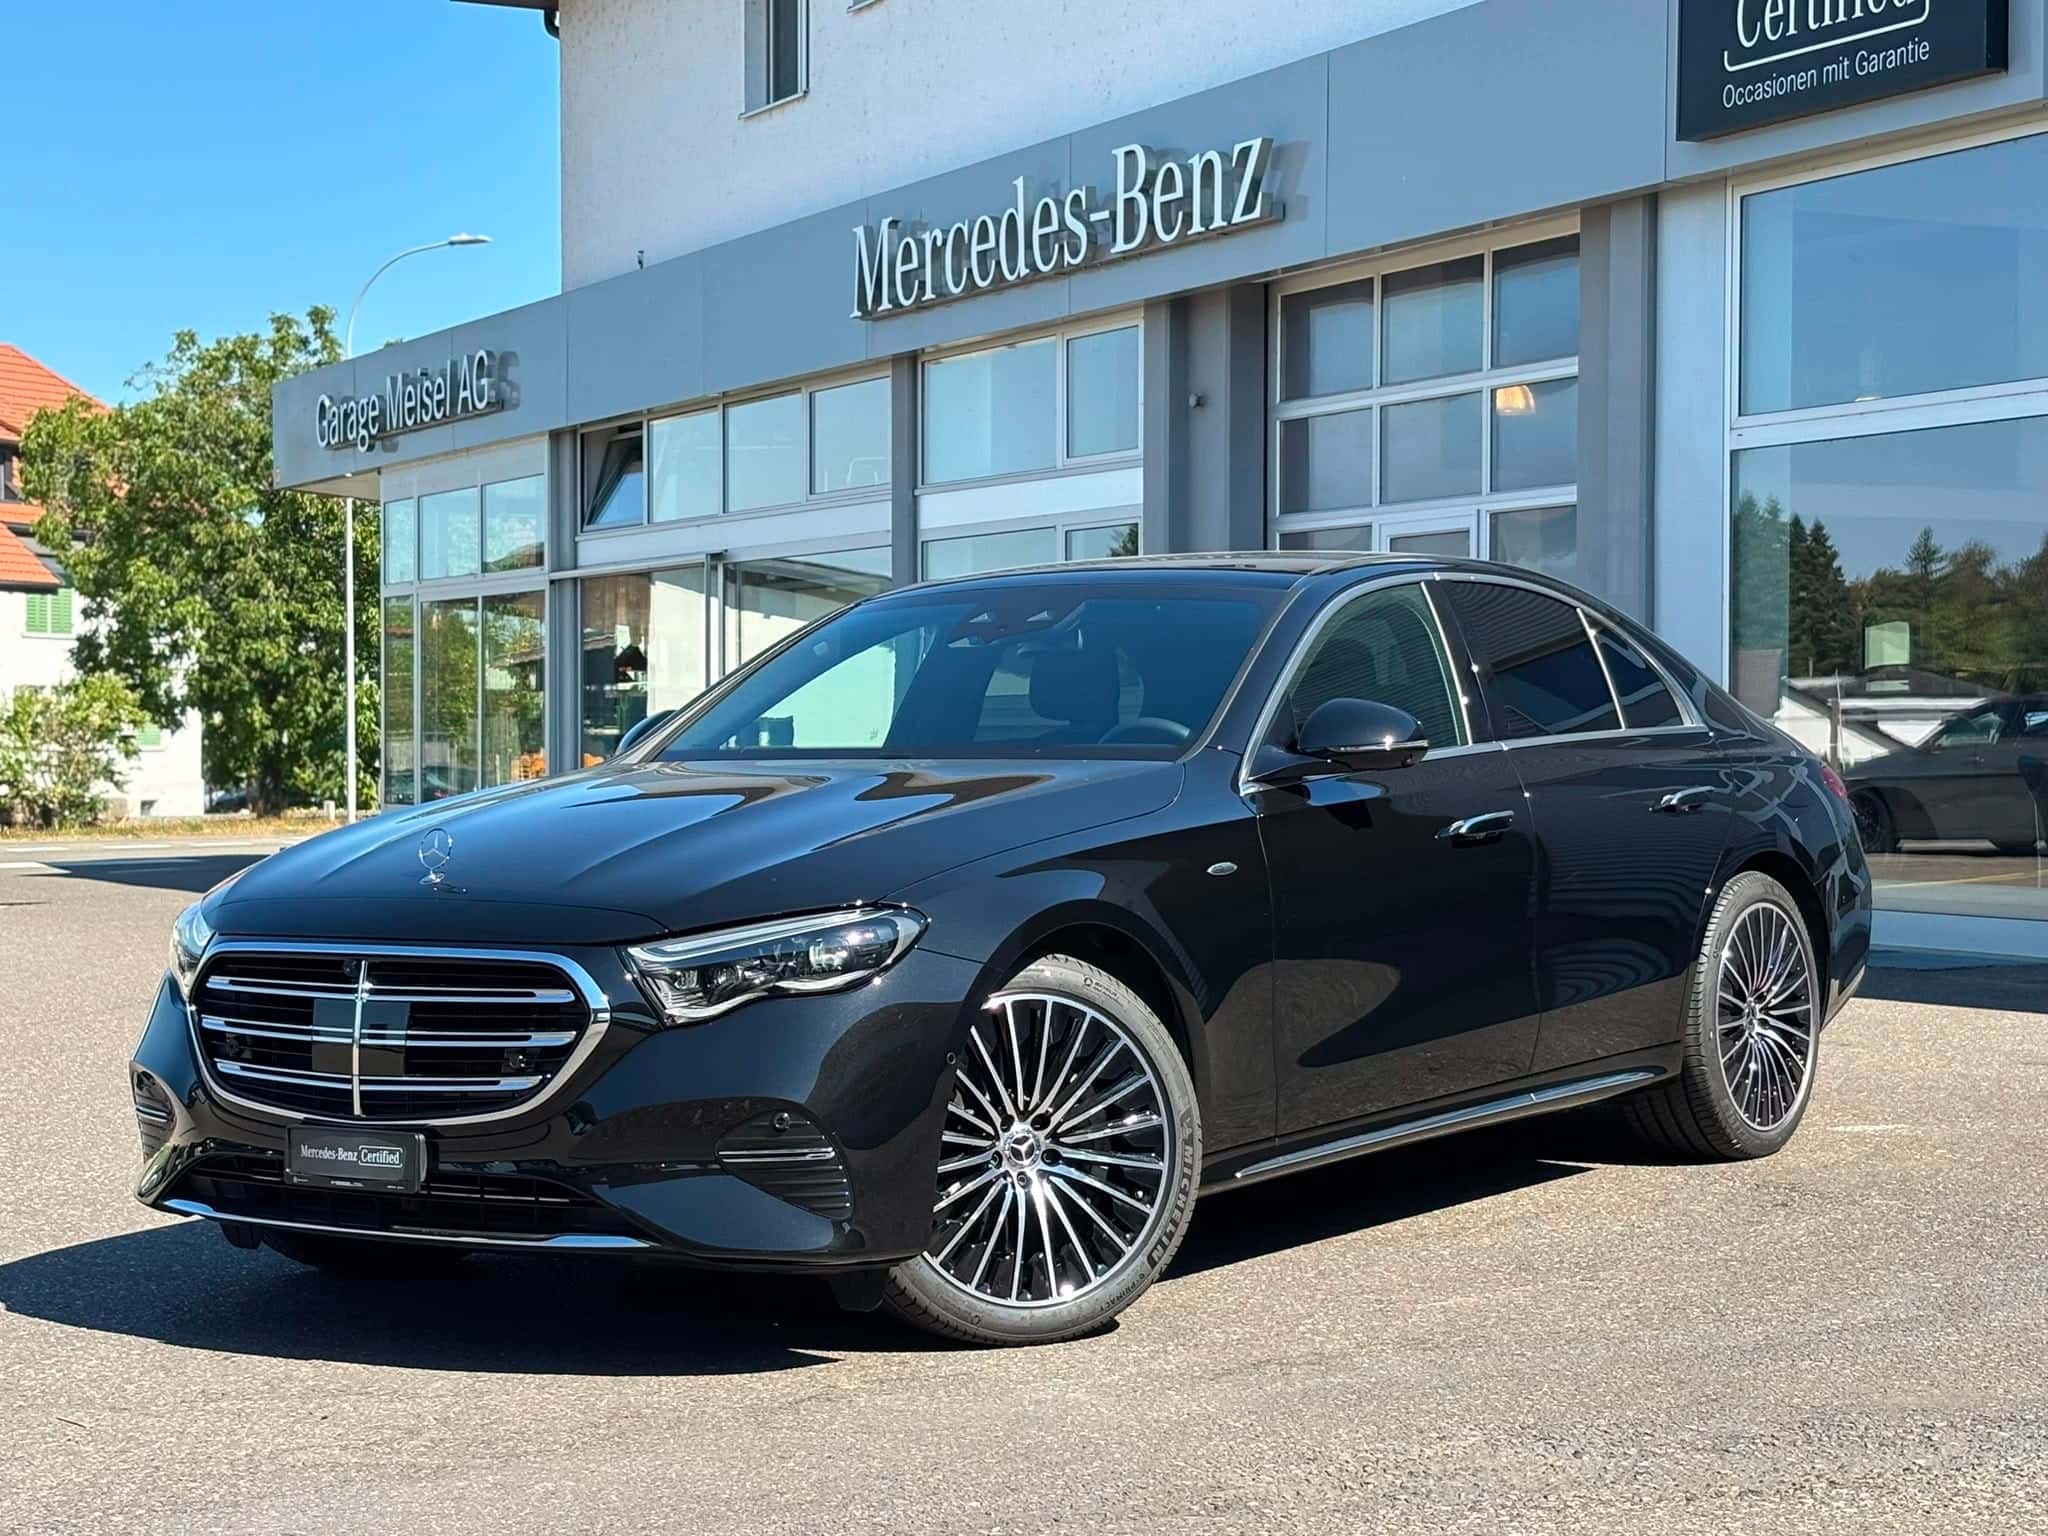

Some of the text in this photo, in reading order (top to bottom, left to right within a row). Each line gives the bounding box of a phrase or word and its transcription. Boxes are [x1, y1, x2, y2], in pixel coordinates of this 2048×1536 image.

[1722, 37, 1930, 109] Occasionen mit Garantie
[849, 136, 1271, 319] Mercedes-Benz
[316, 350, 489, 452] Garage Meisel AG
[300, 1144, 400, 1164] Mercedes-Benz Certified
[1151, 1144, 1193, 1264] MICHELIN
